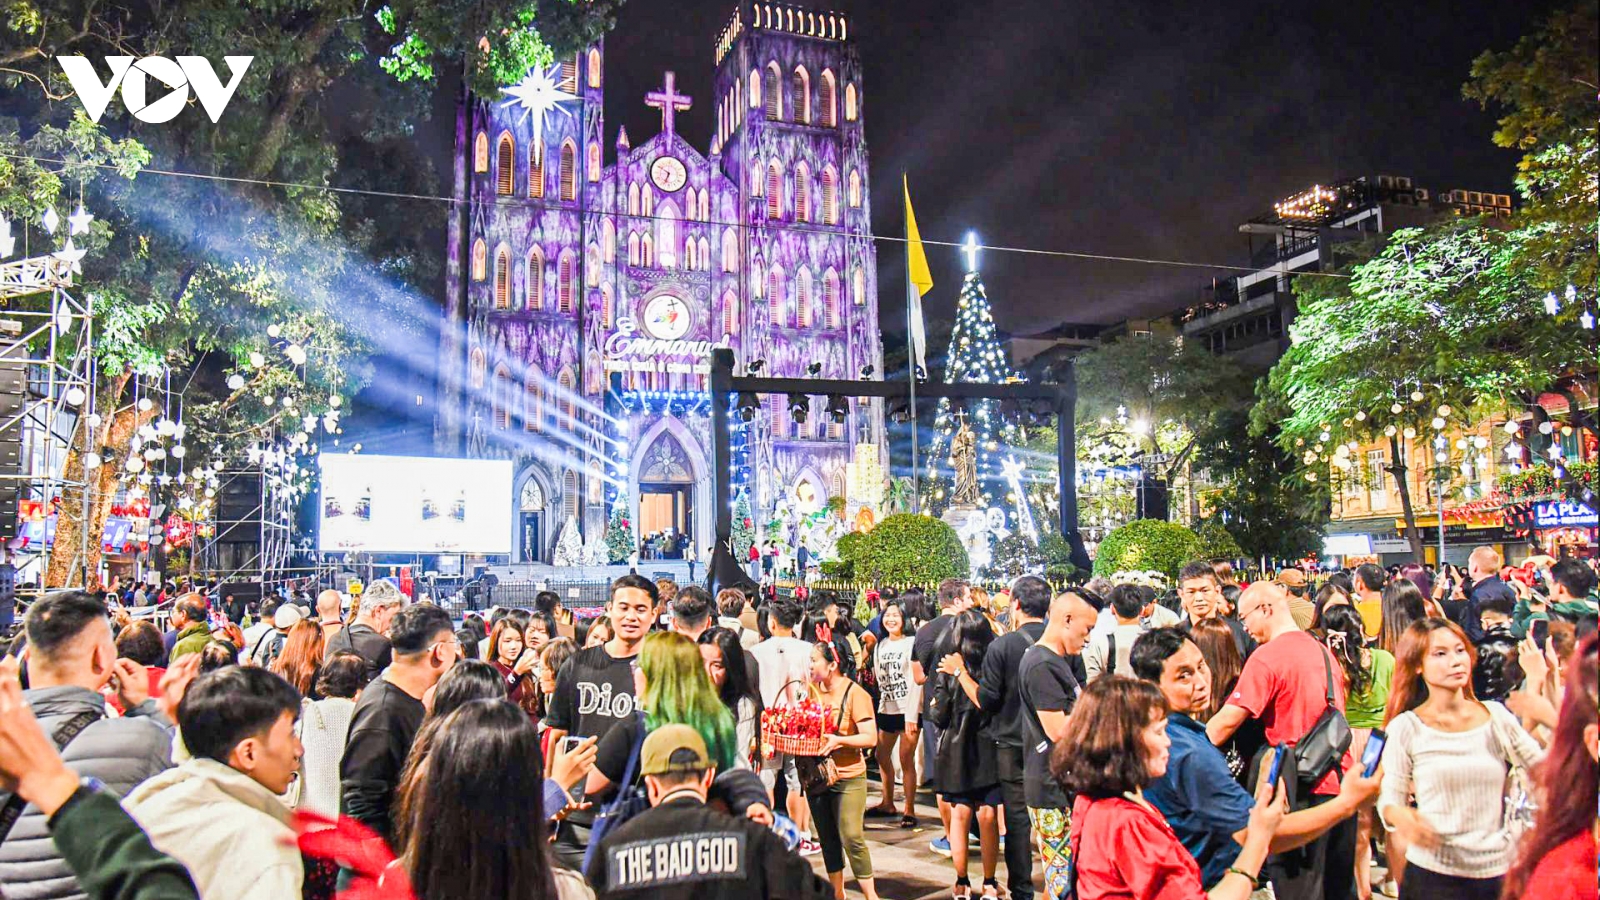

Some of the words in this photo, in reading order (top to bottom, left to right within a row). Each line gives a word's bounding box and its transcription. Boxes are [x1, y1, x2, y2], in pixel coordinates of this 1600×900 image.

[1537, 504, 1558, 518] LA
[1559, 502, 1594, 517] PLA
[616, 845, 653, 885] THE
[655, 840, 693, 880] BAD
[696, 837, 738, 874] GOD
